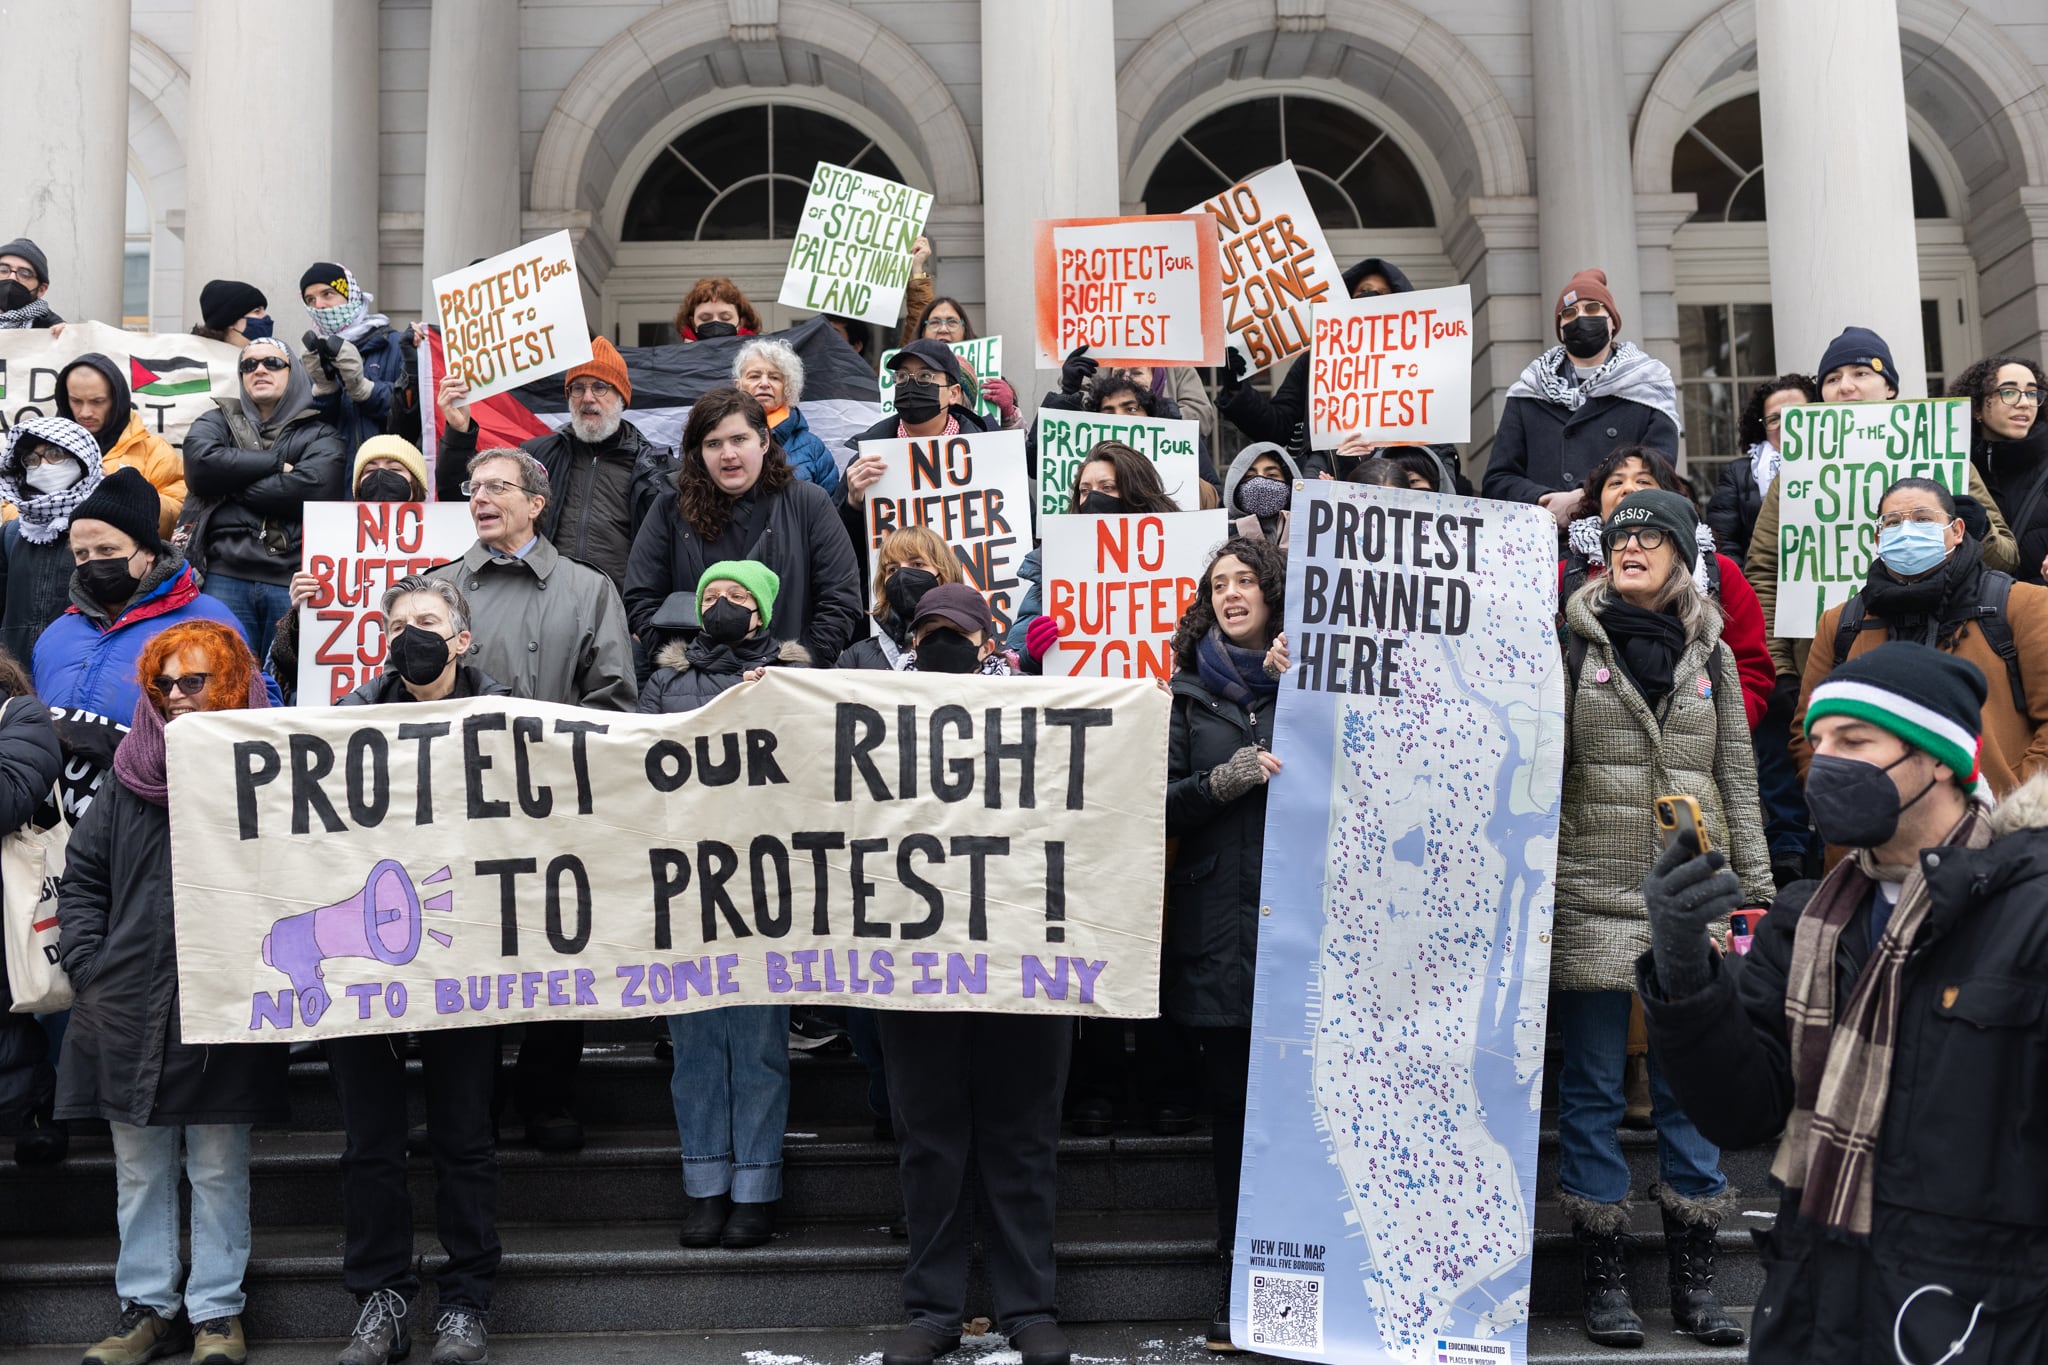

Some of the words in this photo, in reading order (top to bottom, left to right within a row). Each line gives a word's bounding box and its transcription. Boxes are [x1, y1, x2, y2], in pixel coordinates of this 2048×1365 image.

[811, 166, 863, 202] STOP
[861, 188, 881, 199] THE
[876, 183, 930, 224] SALE
[1204, 183, 1261, 241] NO
[808, 206, 828, 220] OF
[823, 203, 920, 255] STOLEN
[1221, 213, 1308, 285] UFFER
[790, 233, 913, 289] PALESTINIAN
[1062, 245, 1169, 281] PROTECT
[1165, 256, 1194, 272] OUR
[439, 256, 543, 330] PROTECT
[540, 259, 572, 282] OUR
[806, 275, 872, 317] LAND
[1062, 282, 1127, 316] RIGHT
[1133, 292, 1157, 304] TO
[1222, 248, 1330, 334] ZONE
[445, 307, 506, 363] RIGHT
[512, 306, 537, 326] TO
[450, 324, 555, 392] PROTEST
[1063, 314, 1171, 350] PROTEST
[1243, 294, 1329, 369] BILL
[1315, 309, 1437, 357] PROTECT
[1432, 320, 1468, 339] OUR
[1314, 353, 1386, 395] RIGHT
[1391, 363, 1419, 379] TO
[1314, 389, 1435, 435] PROTEST
[1782, 408, 1855, 461] STOP
[1856, 424, 1886, 440] THE
[1886, 400, 1967, 461] SALE
[908, 437, 973, 491] NO
[1160, 438, 1195, 456] OUR
[871, 488, 1012, 550] BUFFER
[1613, 507, 1654, 525] RESIST
[1787, 480, 1813, 499] OF
[1814, 461, 1964, 522] STON
[357, 502, 424, 554] NO
[1096, 516, 1165, 574] NO
[1306, 499, 1484, 573] PROTEST
[307, 554, 452, 609] BUFF
[1050, 576, 1198, 638] BUFFER
[1301, 565, 1472, 636] BANNED
[1058, 639, 1174, 682] ZON
[1296, 632, 1404, 698] HERE
[233, 712, 610, 841] PROTECT
[644, 728, 790, 792] OUR
[833, 702, 1113, 810] RIGHT
[474, 853, 593, 957] TO
[248, 986, 325, 1031] NO
[345, 981, 408, 1020] TO
[434, 968, 599, 1015] BUFFER
[616, 953, 740, 1008] ZONE
[766, 948, 895, 994] BILLS
[911, 952, 988, 995] IN
[1021, 955, 1109, 1004] NY
[1250, 1256, 1265, 1267] WITH
[1266, 1258, 1277, 1268] ALL
[1279, 1259, 1292, 1269] FIVE
[1293, 1260, 1325, 1272] BOROUGHS
[1251, 1239, 1275, 1256] VIEW
[1278, 1241, 1301, 1258] FULL
[1304, 1243, 1326, 1260] MAP
[1448, 1342, 1480, 1353] EDUCATIONAL
[1481, 1345, 1506, 1354] FACILITIES
